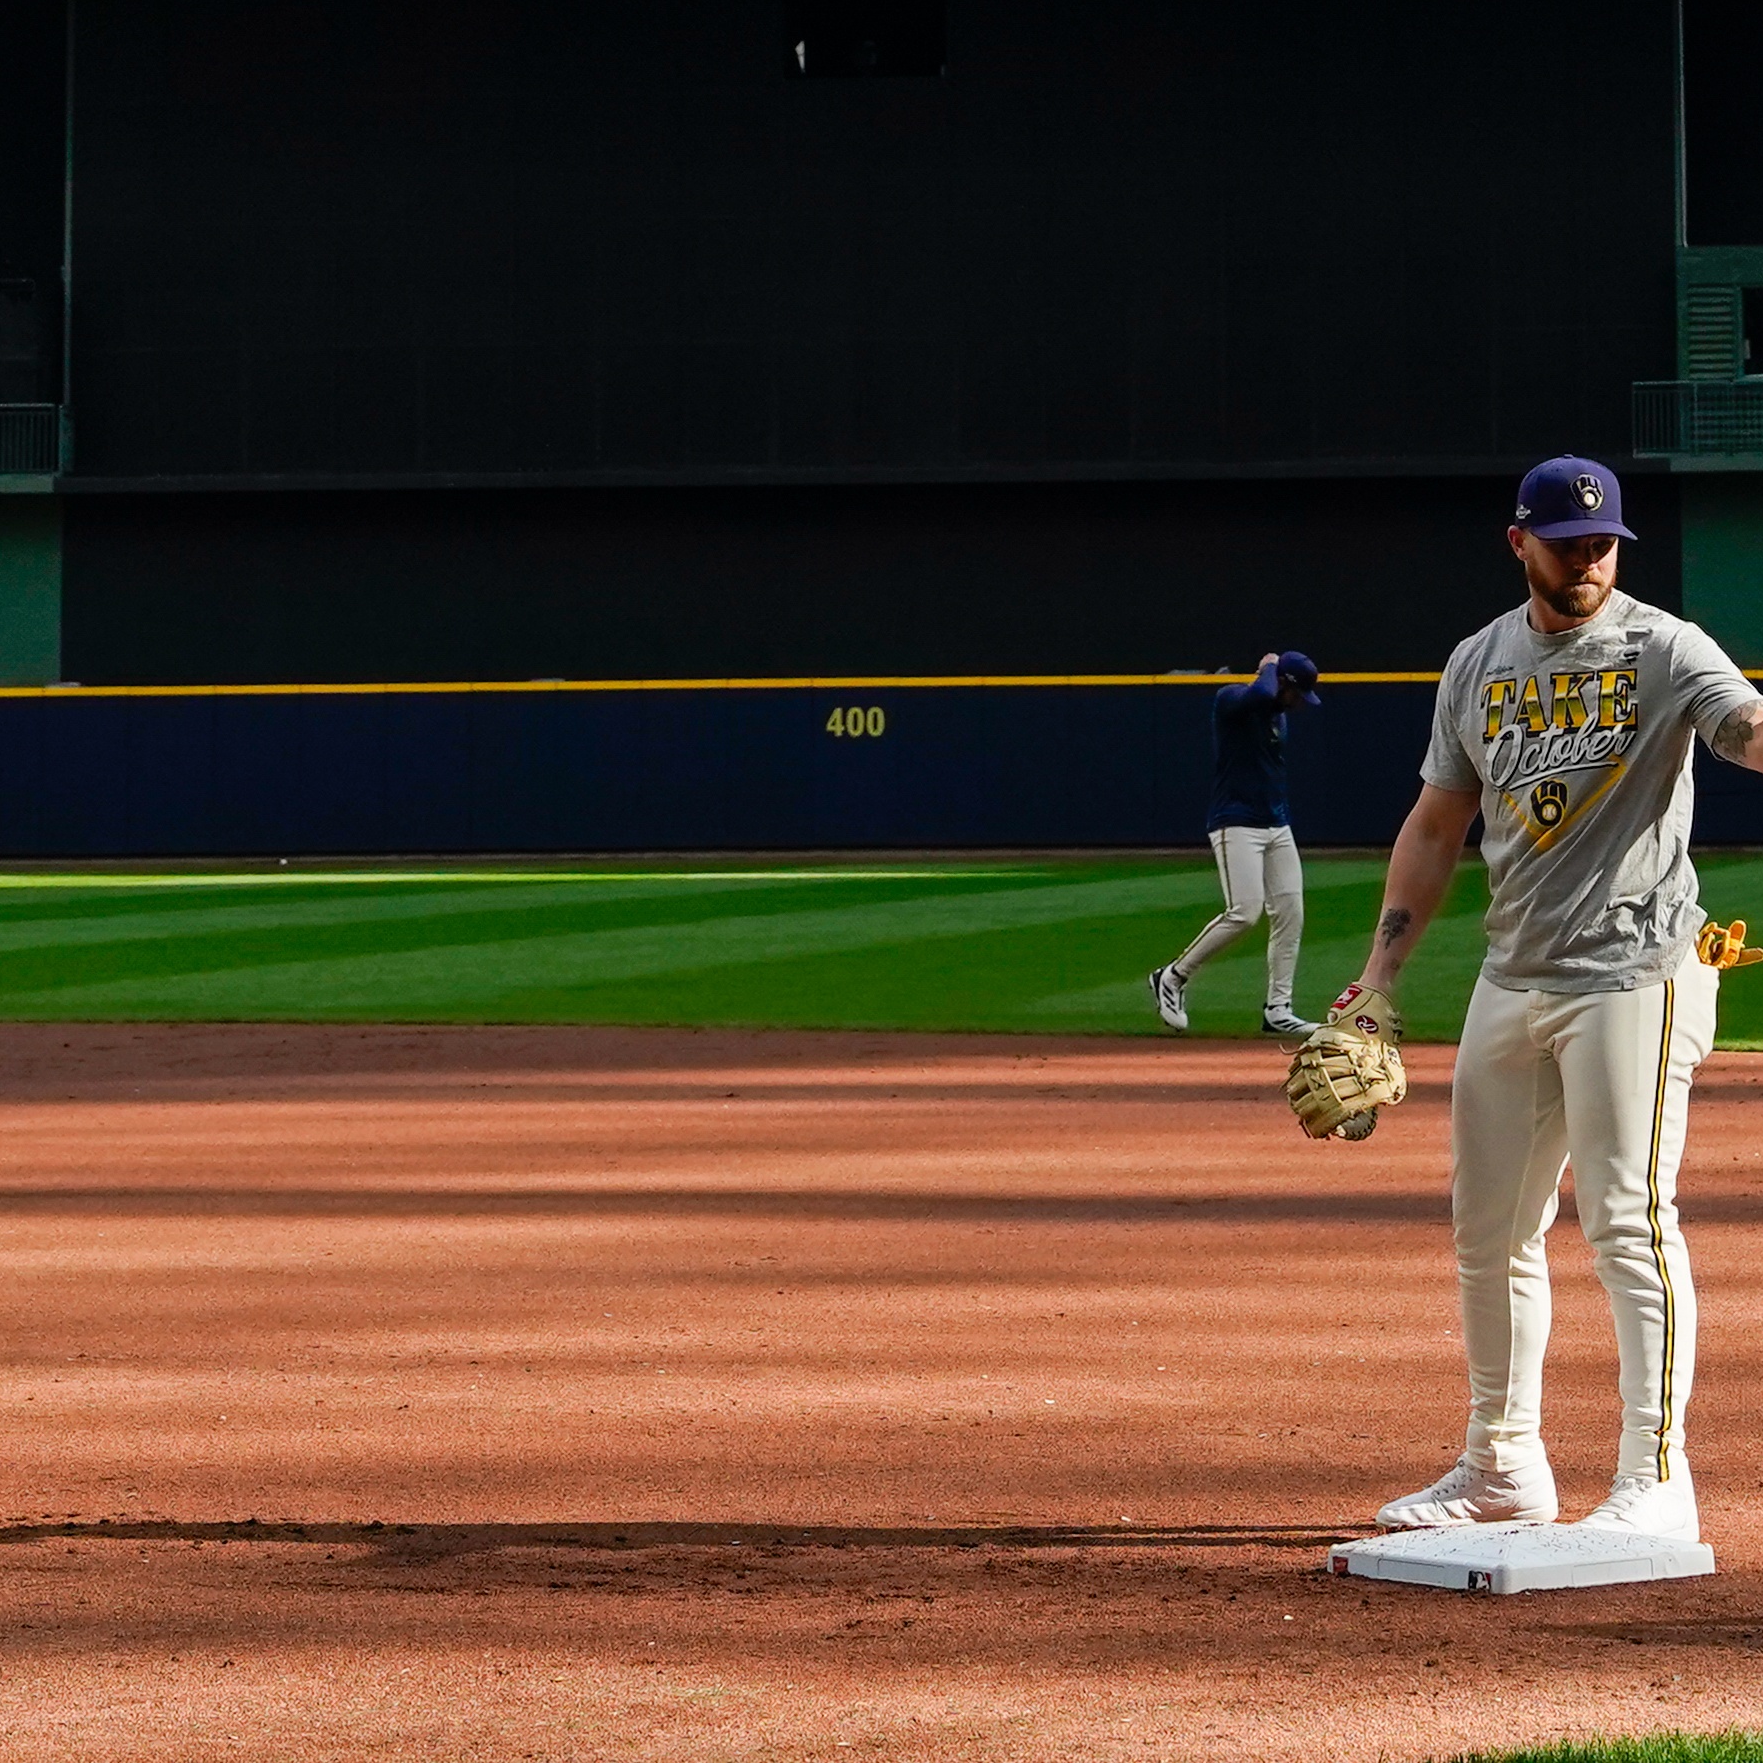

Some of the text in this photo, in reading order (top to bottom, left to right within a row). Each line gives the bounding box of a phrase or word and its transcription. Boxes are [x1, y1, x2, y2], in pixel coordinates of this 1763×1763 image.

[826, 706, 886, 737] 400
[1480, 668, 1638, 744] TAKE
[1487, 711, 1636, 787] October
